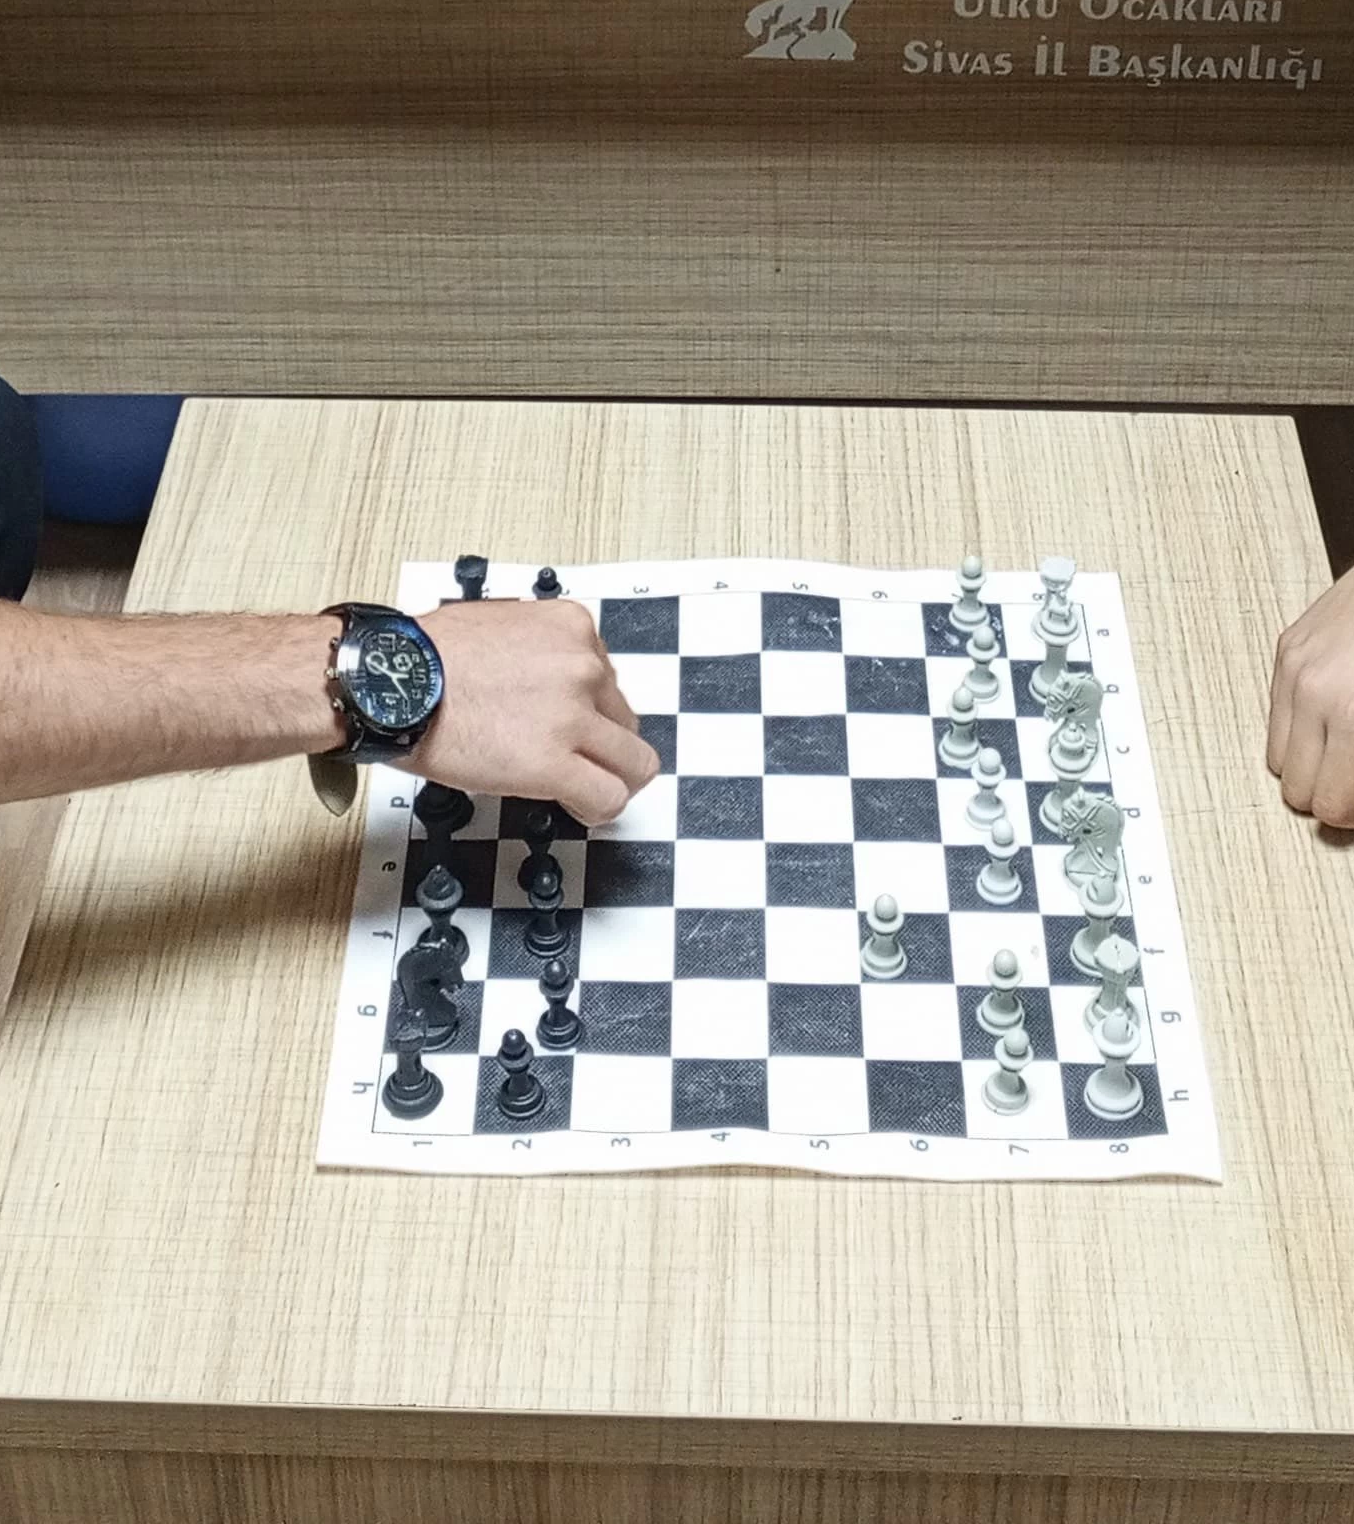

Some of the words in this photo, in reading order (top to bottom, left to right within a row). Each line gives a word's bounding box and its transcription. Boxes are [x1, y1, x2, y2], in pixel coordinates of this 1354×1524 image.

[512, 1138, 532, 1150] 2
[611, 1136, 631, 1148] 3
[710, 1130, 731, 1143] 4
[809, 1138, 830, 1151] 5
[909, 1138, 929, 1152] 6
[1008, 1143, 1030, 1156] 7
[1109, 1142, 1130, 1155] 8
